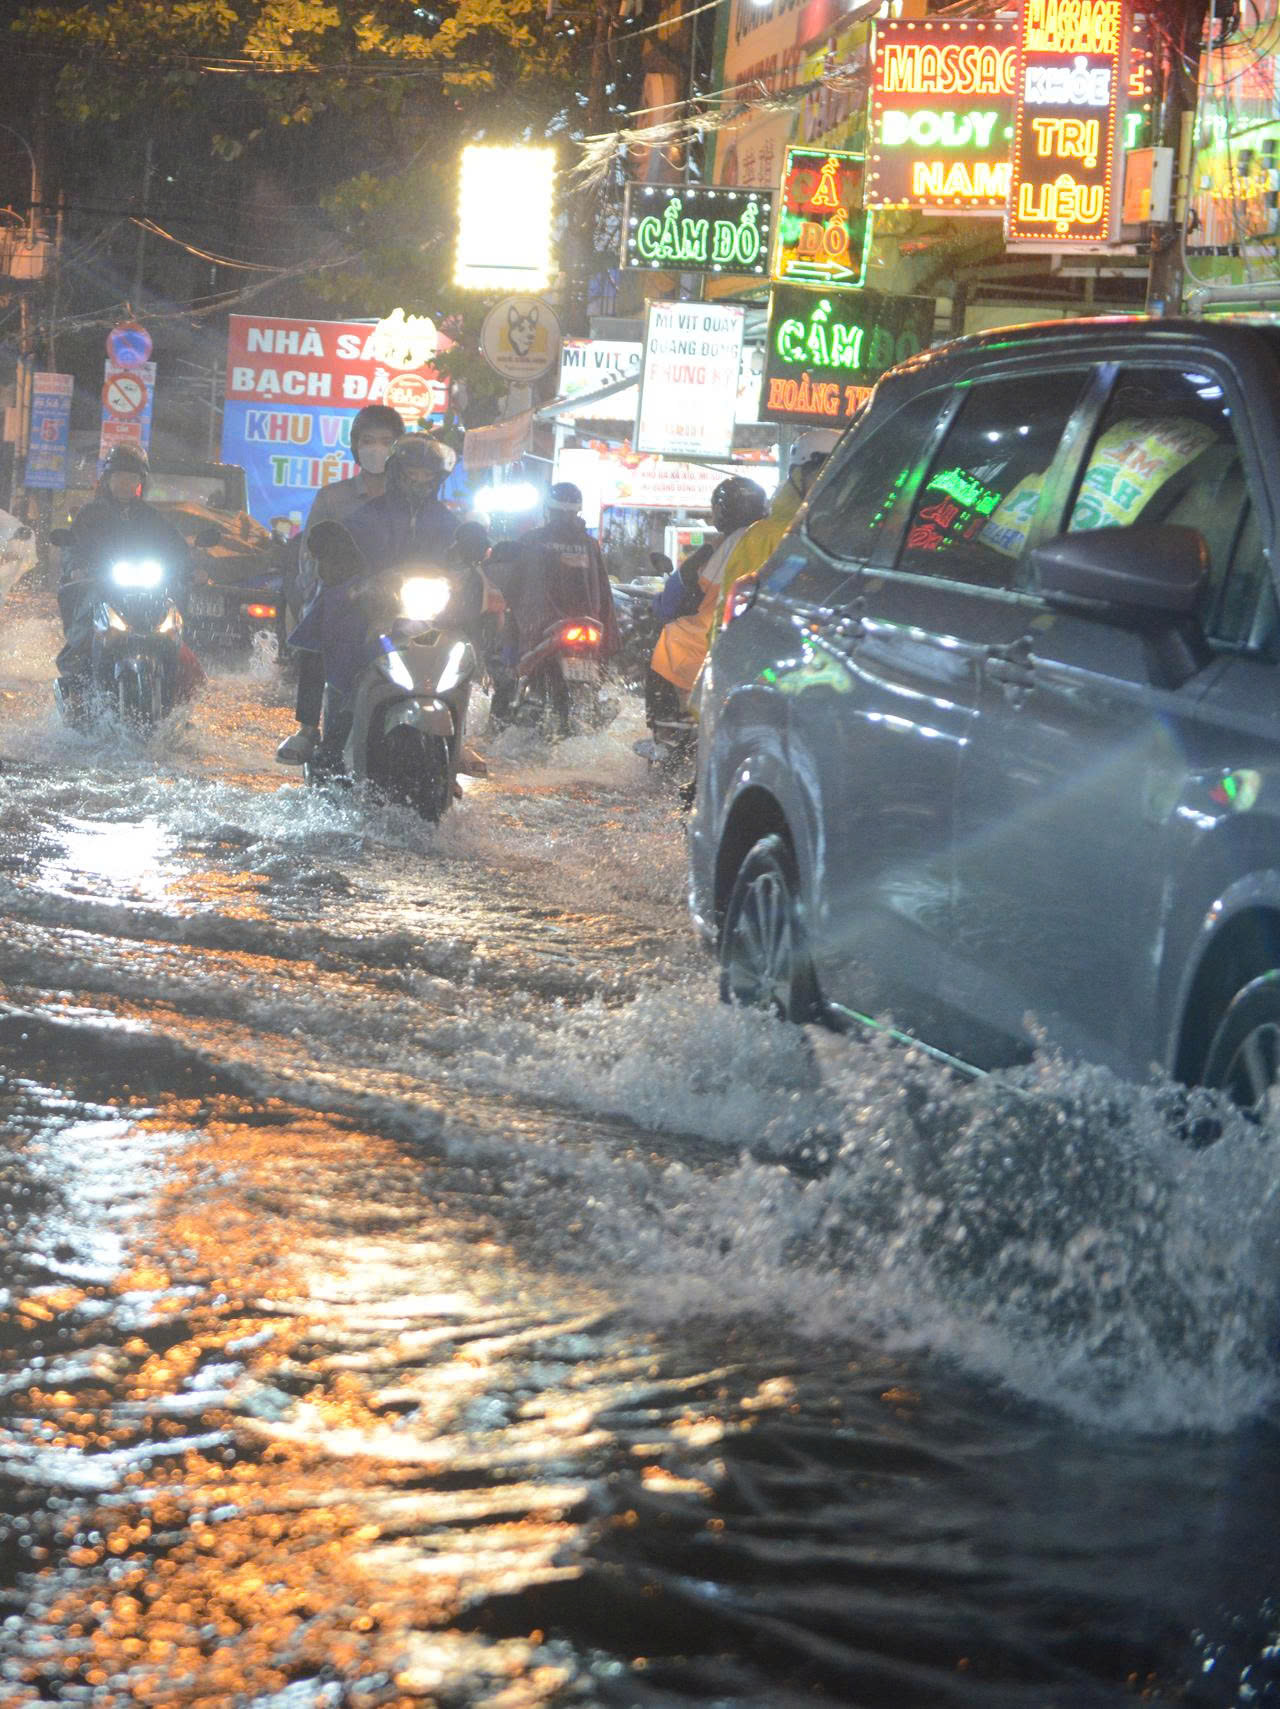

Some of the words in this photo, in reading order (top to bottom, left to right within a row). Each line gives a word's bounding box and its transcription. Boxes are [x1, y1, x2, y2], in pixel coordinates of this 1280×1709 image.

[882, 110, 998, 147] BODY
[1032, 117, 1100, 168] TRỊ
[913, 160, 1013, 197] NAM
[1018, 173, 1105, 233] LIỆU
[638, 197, 709, 262] CẦM
[711, 201, 760, 264] ĐỒ
[247, 326, 325, 358] NHÀ
[777, 299, 864, 369] CẦM
[231, 366, 332, 399] BẠCH
[342, 367, 448, 406] ĐẰG
[245, 409, 313, 446] KHU
